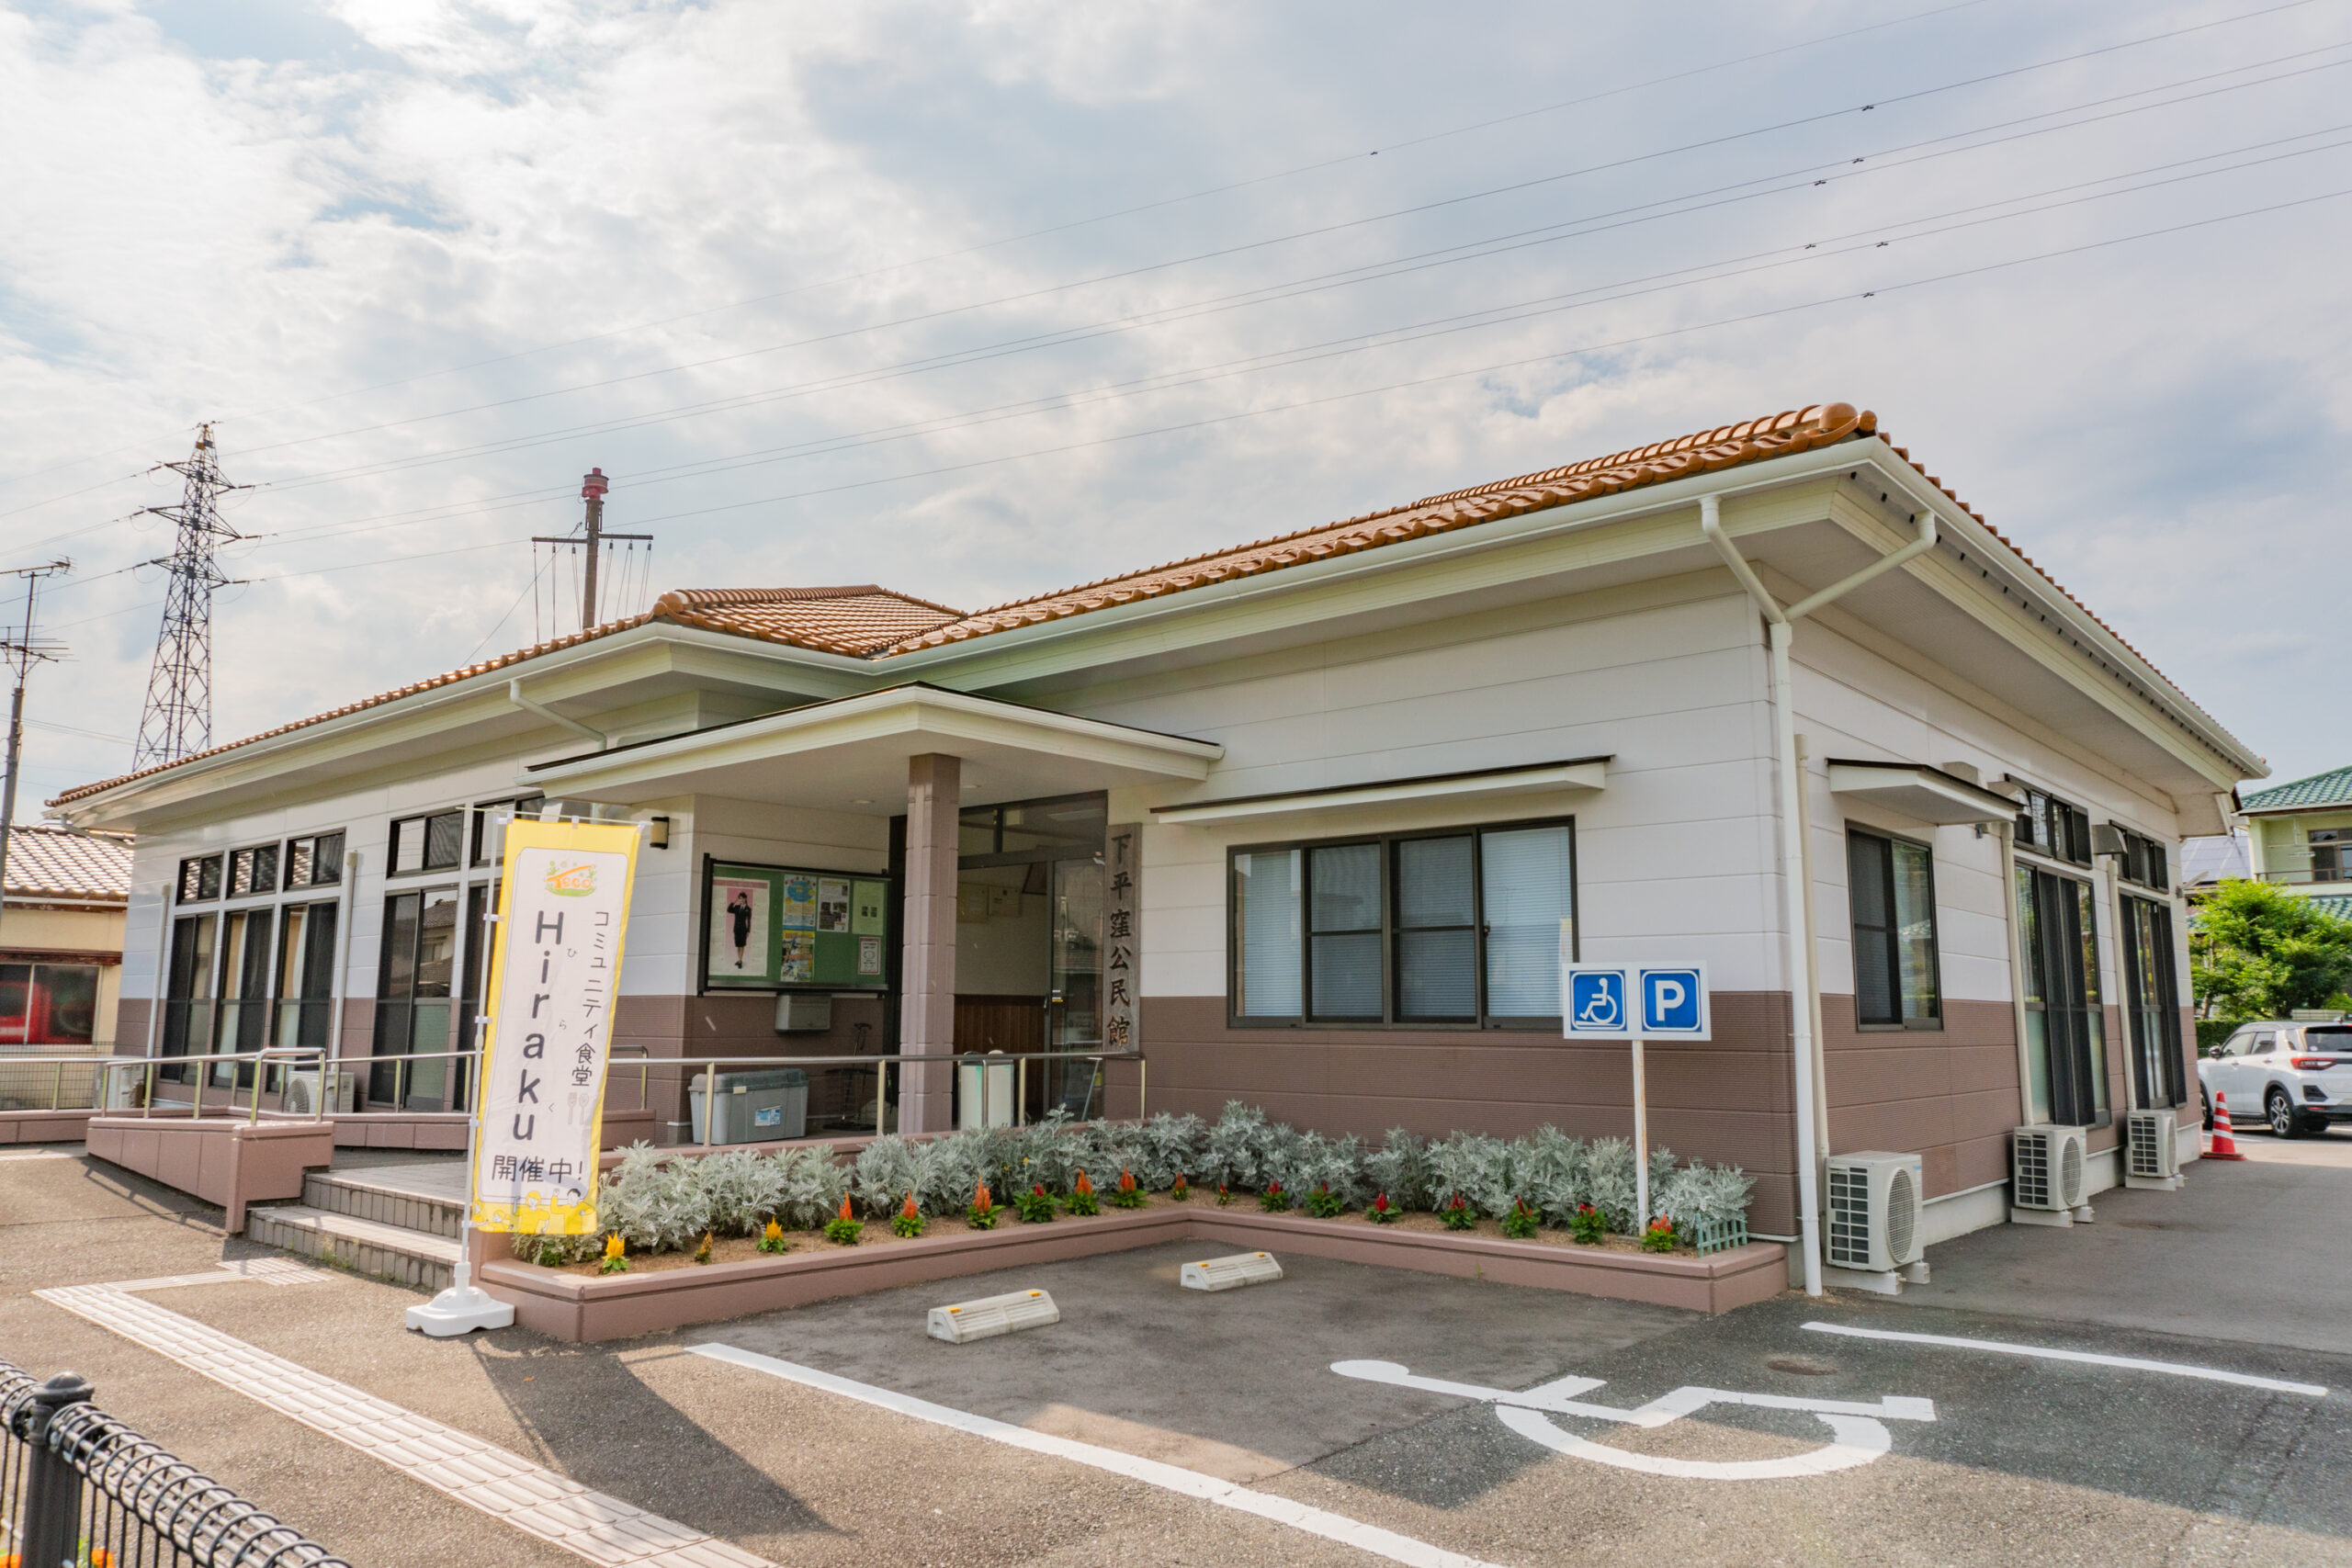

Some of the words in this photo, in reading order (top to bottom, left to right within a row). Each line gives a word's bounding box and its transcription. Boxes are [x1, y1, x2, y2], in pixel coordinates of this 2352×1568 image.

[512, 910, 564, 1141] Hiraku
[571, 911, 609, 1087] コミュニティ食堂
[1107, 833, 1132, 1045] 下平窪公民館
[1655, 979, 1686, 1021] P
[492, 1155, 583, 1183] 開催中!
